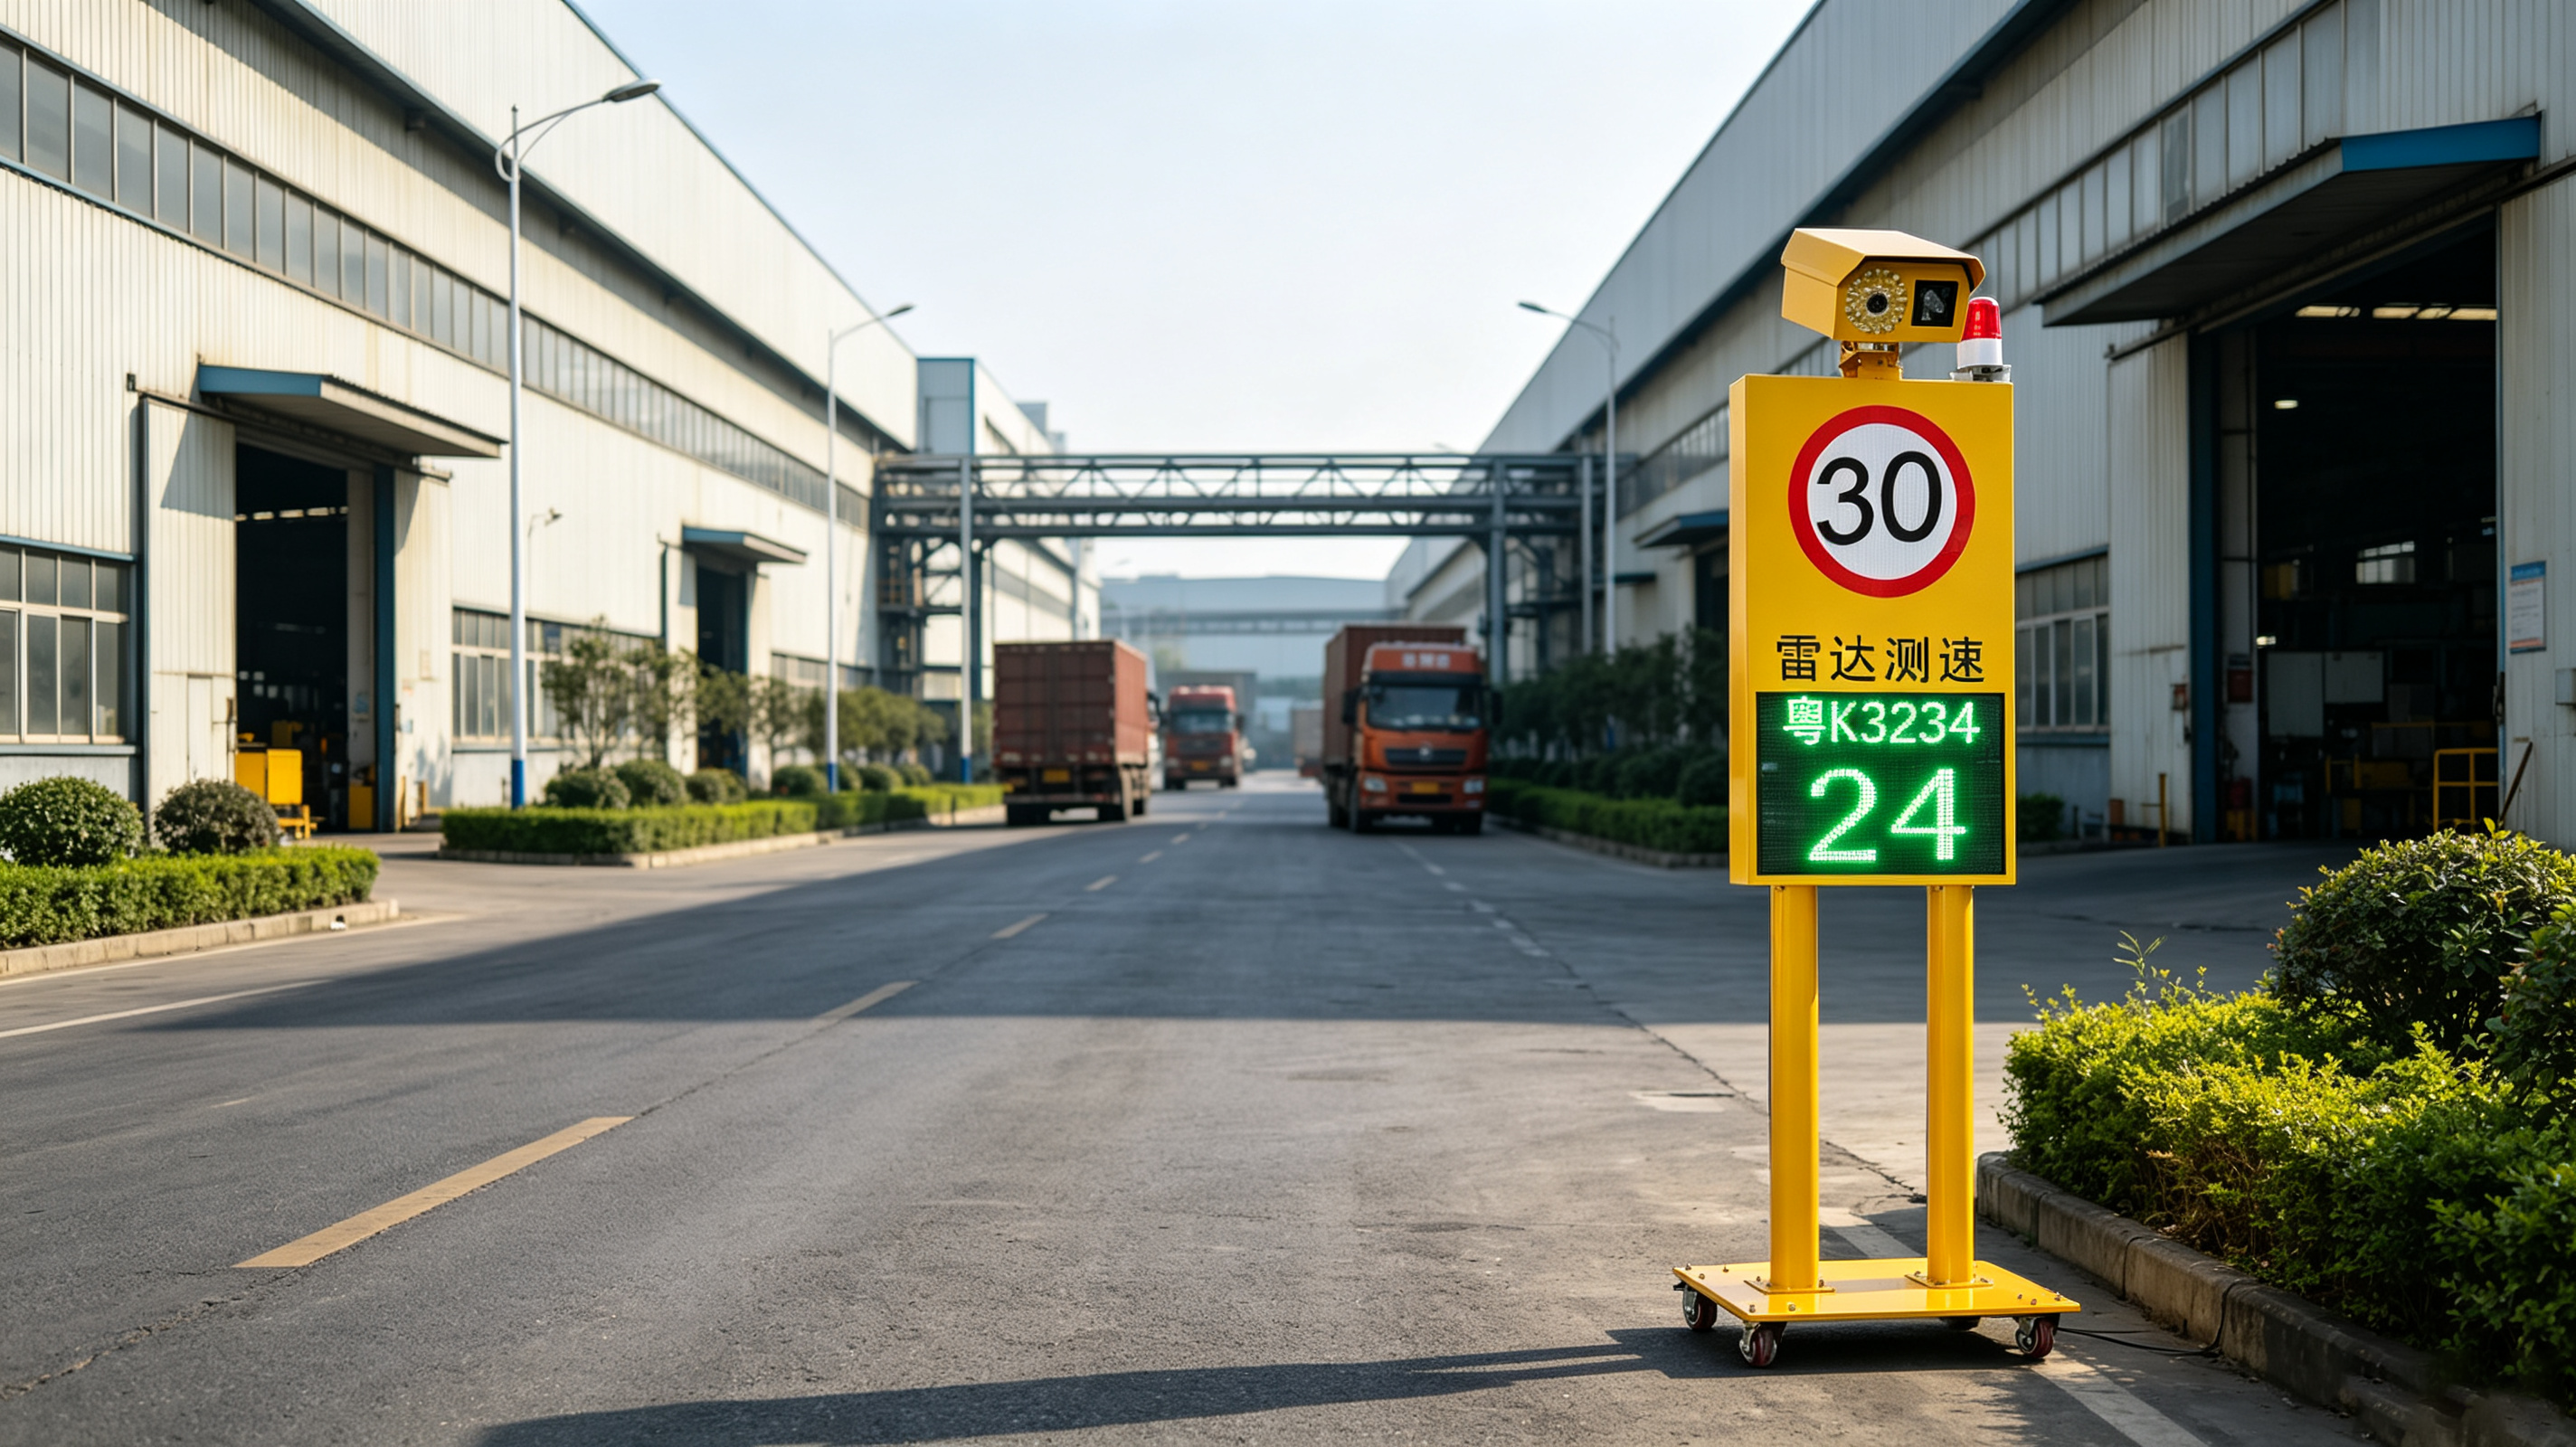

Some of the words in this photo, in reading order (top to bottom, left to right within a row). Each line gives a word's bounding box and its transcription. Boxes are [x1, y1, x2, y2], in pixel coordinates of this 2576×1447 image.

[1816, 450, 1942, 546] 30
[1776, 634, 1984, 683] 雷达测速
[1783, 695, 1981, 745] 粤K3234
[1808, 768, 1967, 861] 24
